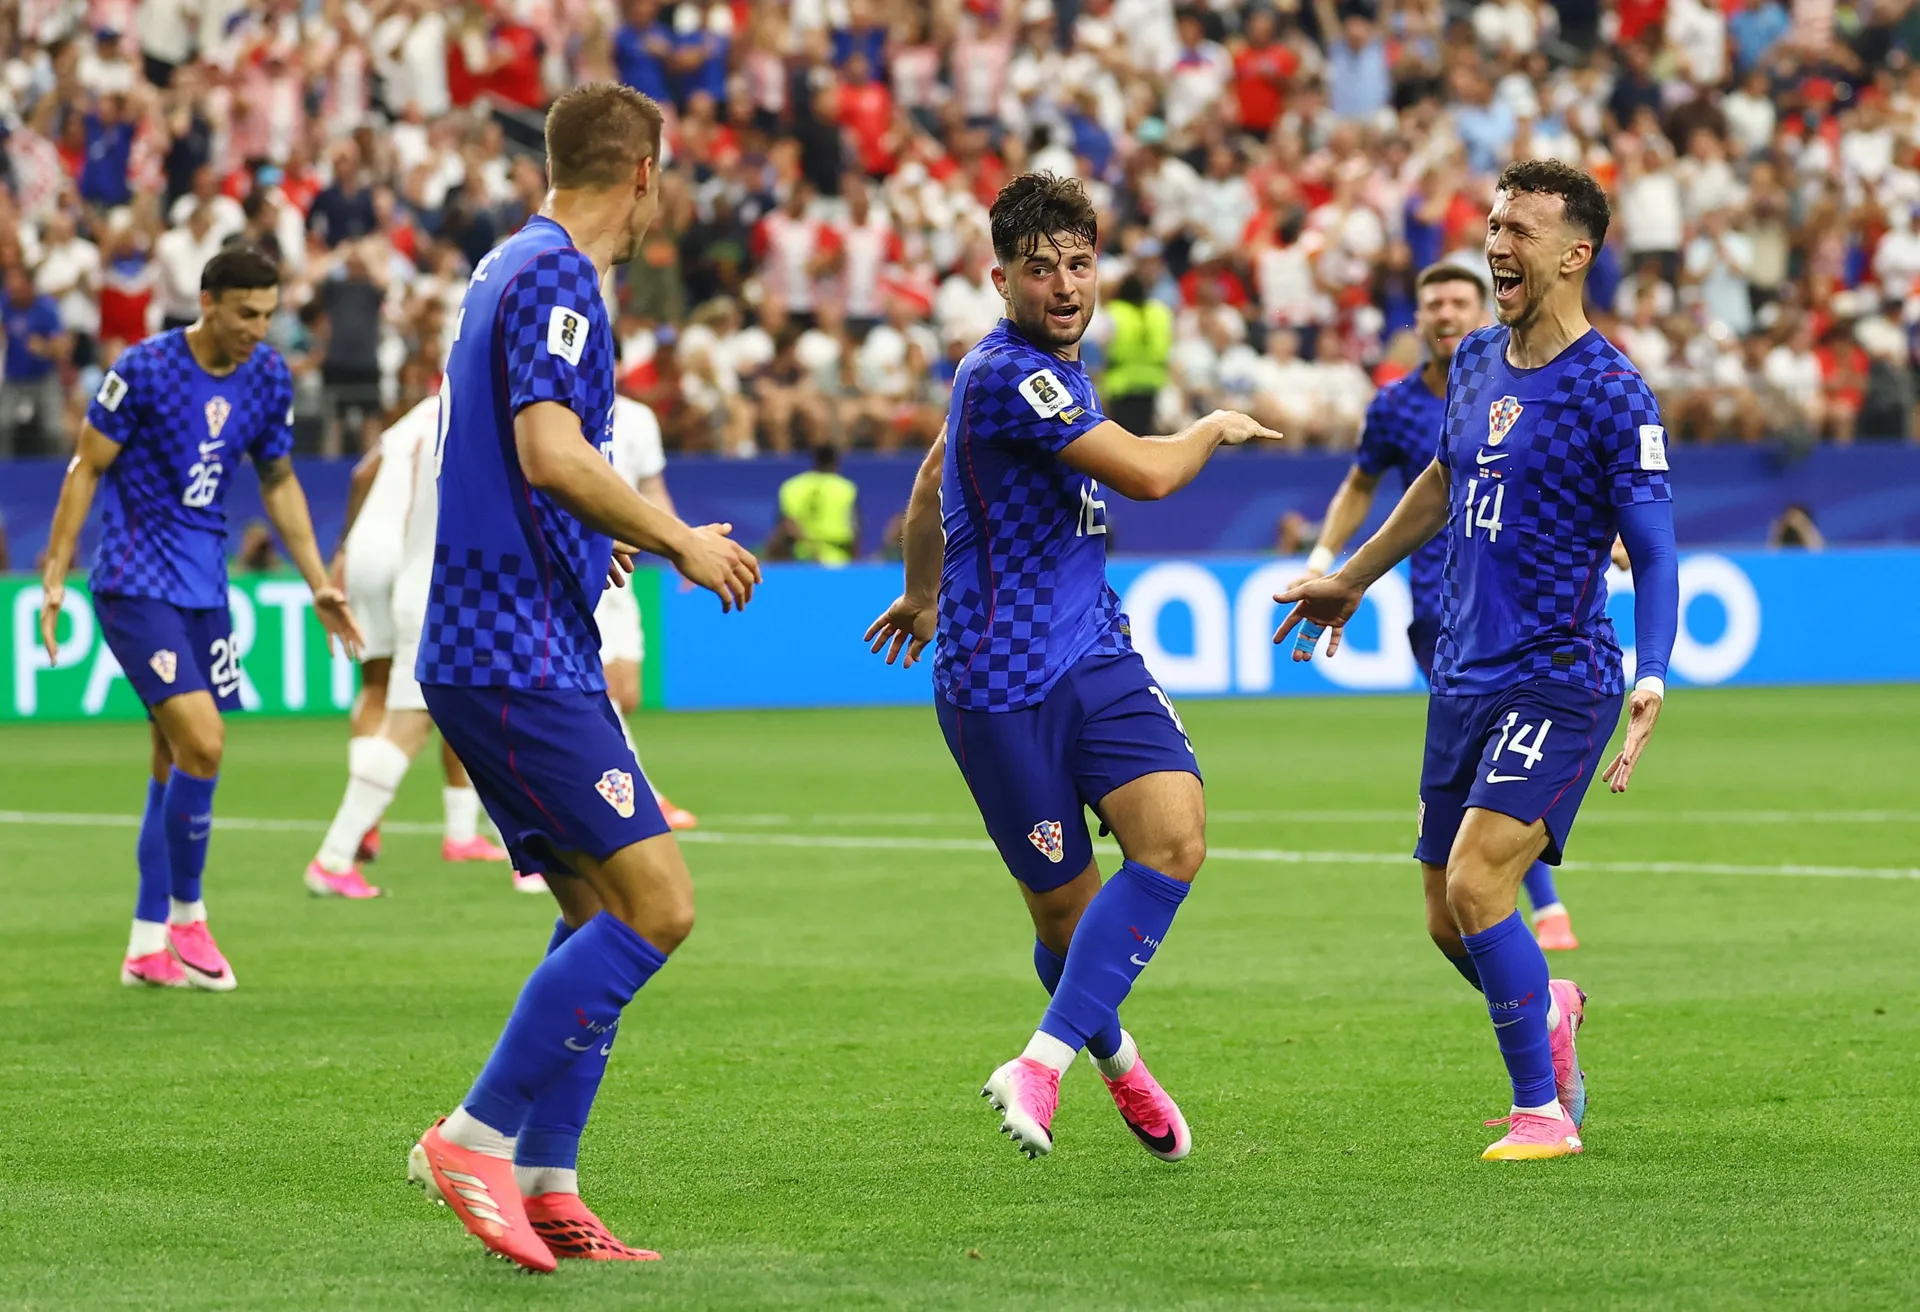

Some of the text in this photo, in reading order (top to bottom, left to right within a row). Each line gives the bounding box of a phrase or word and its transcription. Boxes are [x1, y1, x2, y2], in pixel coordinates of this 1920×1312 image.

[182, 463, 223, 508] 26
[1076, 478, 1106, 537] 16
[1465, 478, 1505, 543] 14
[1121, 553, 1762, 694] arao
[1492, 711, 1553, 770] 14
[1488, 999, 1519, 1010] HNS
